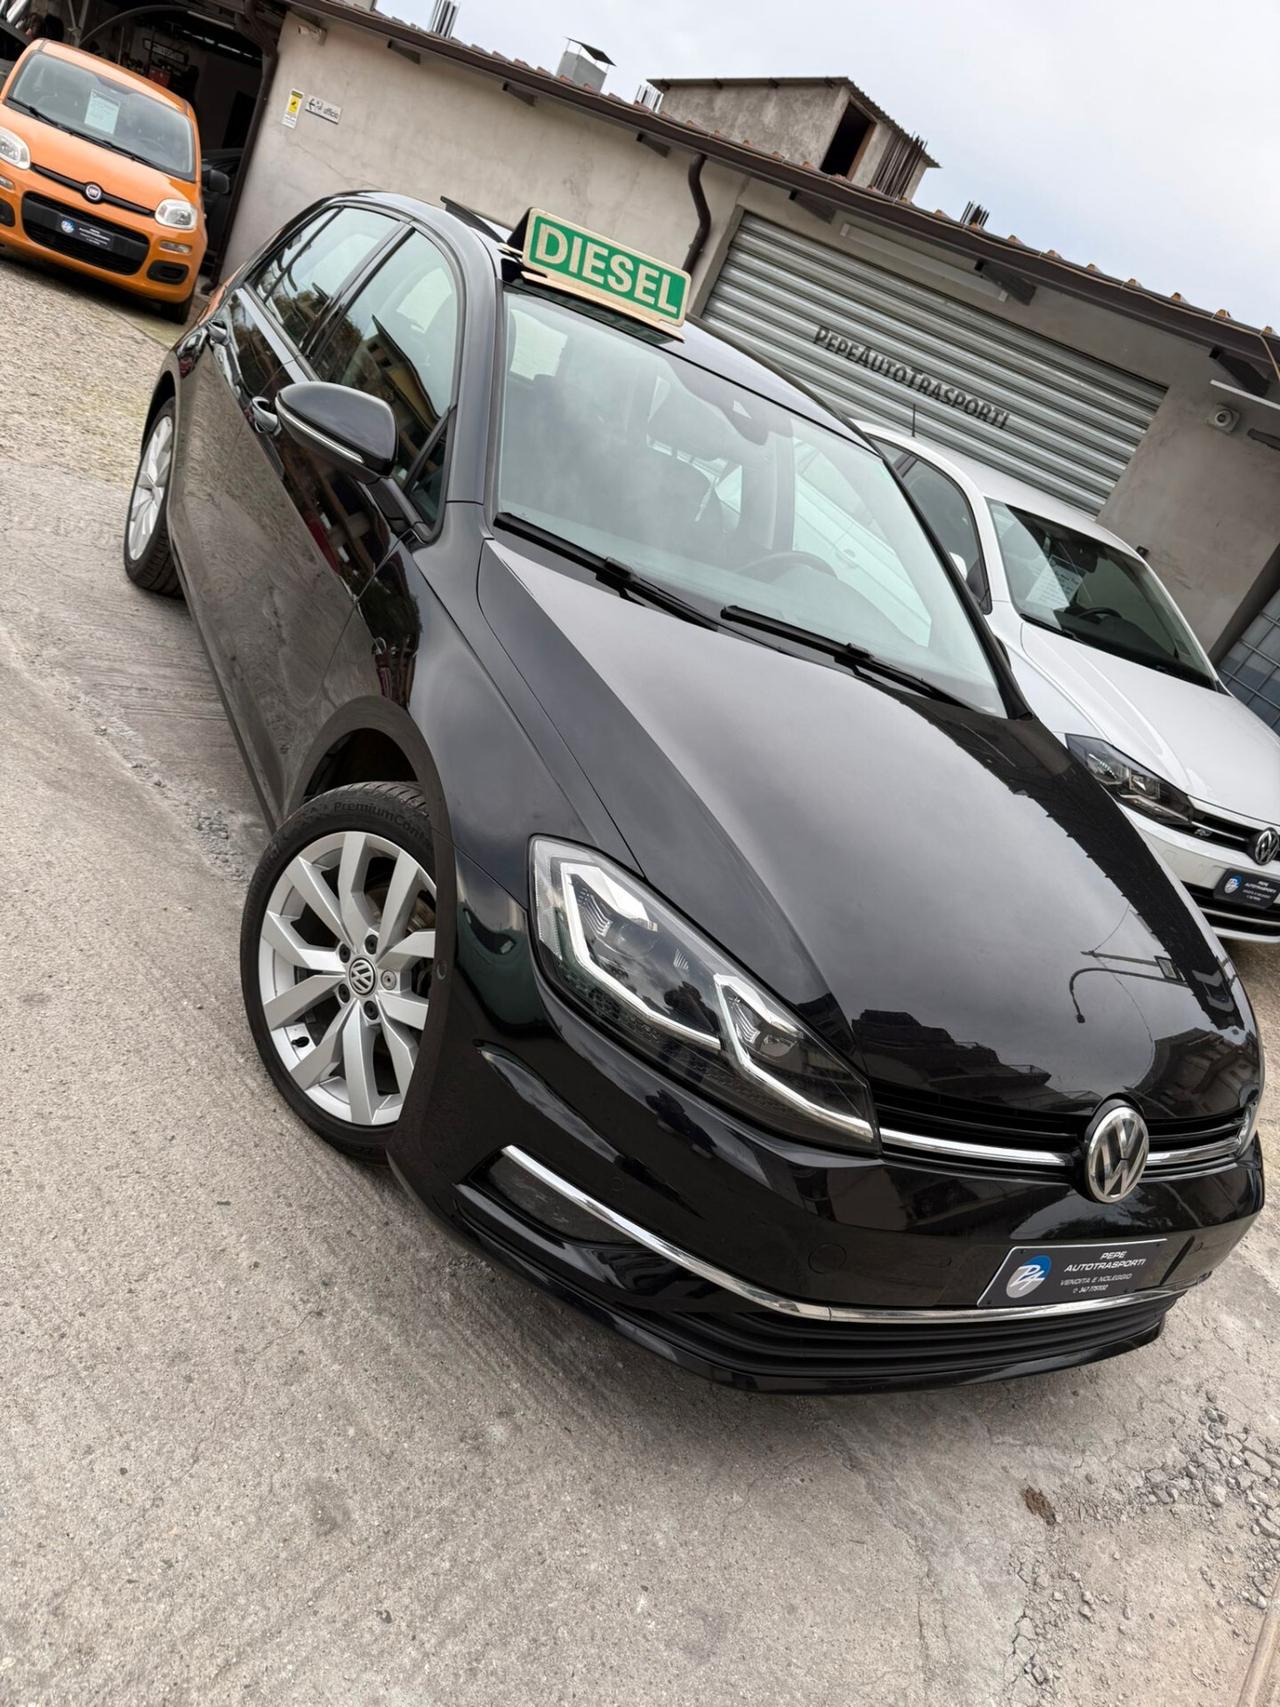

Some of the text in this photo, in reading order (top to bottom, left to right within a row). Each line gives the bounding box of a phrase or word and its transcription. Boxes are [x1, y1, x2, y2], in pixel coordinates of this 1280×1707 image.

[535, 222, 678, 314] DIESEL
[1091, 1110, 1148, 1202] VW
[1064, 1258, 1147, 1273] AUTOTRASPORTI
[1100, 1251, 1127, 1260] PEPE
